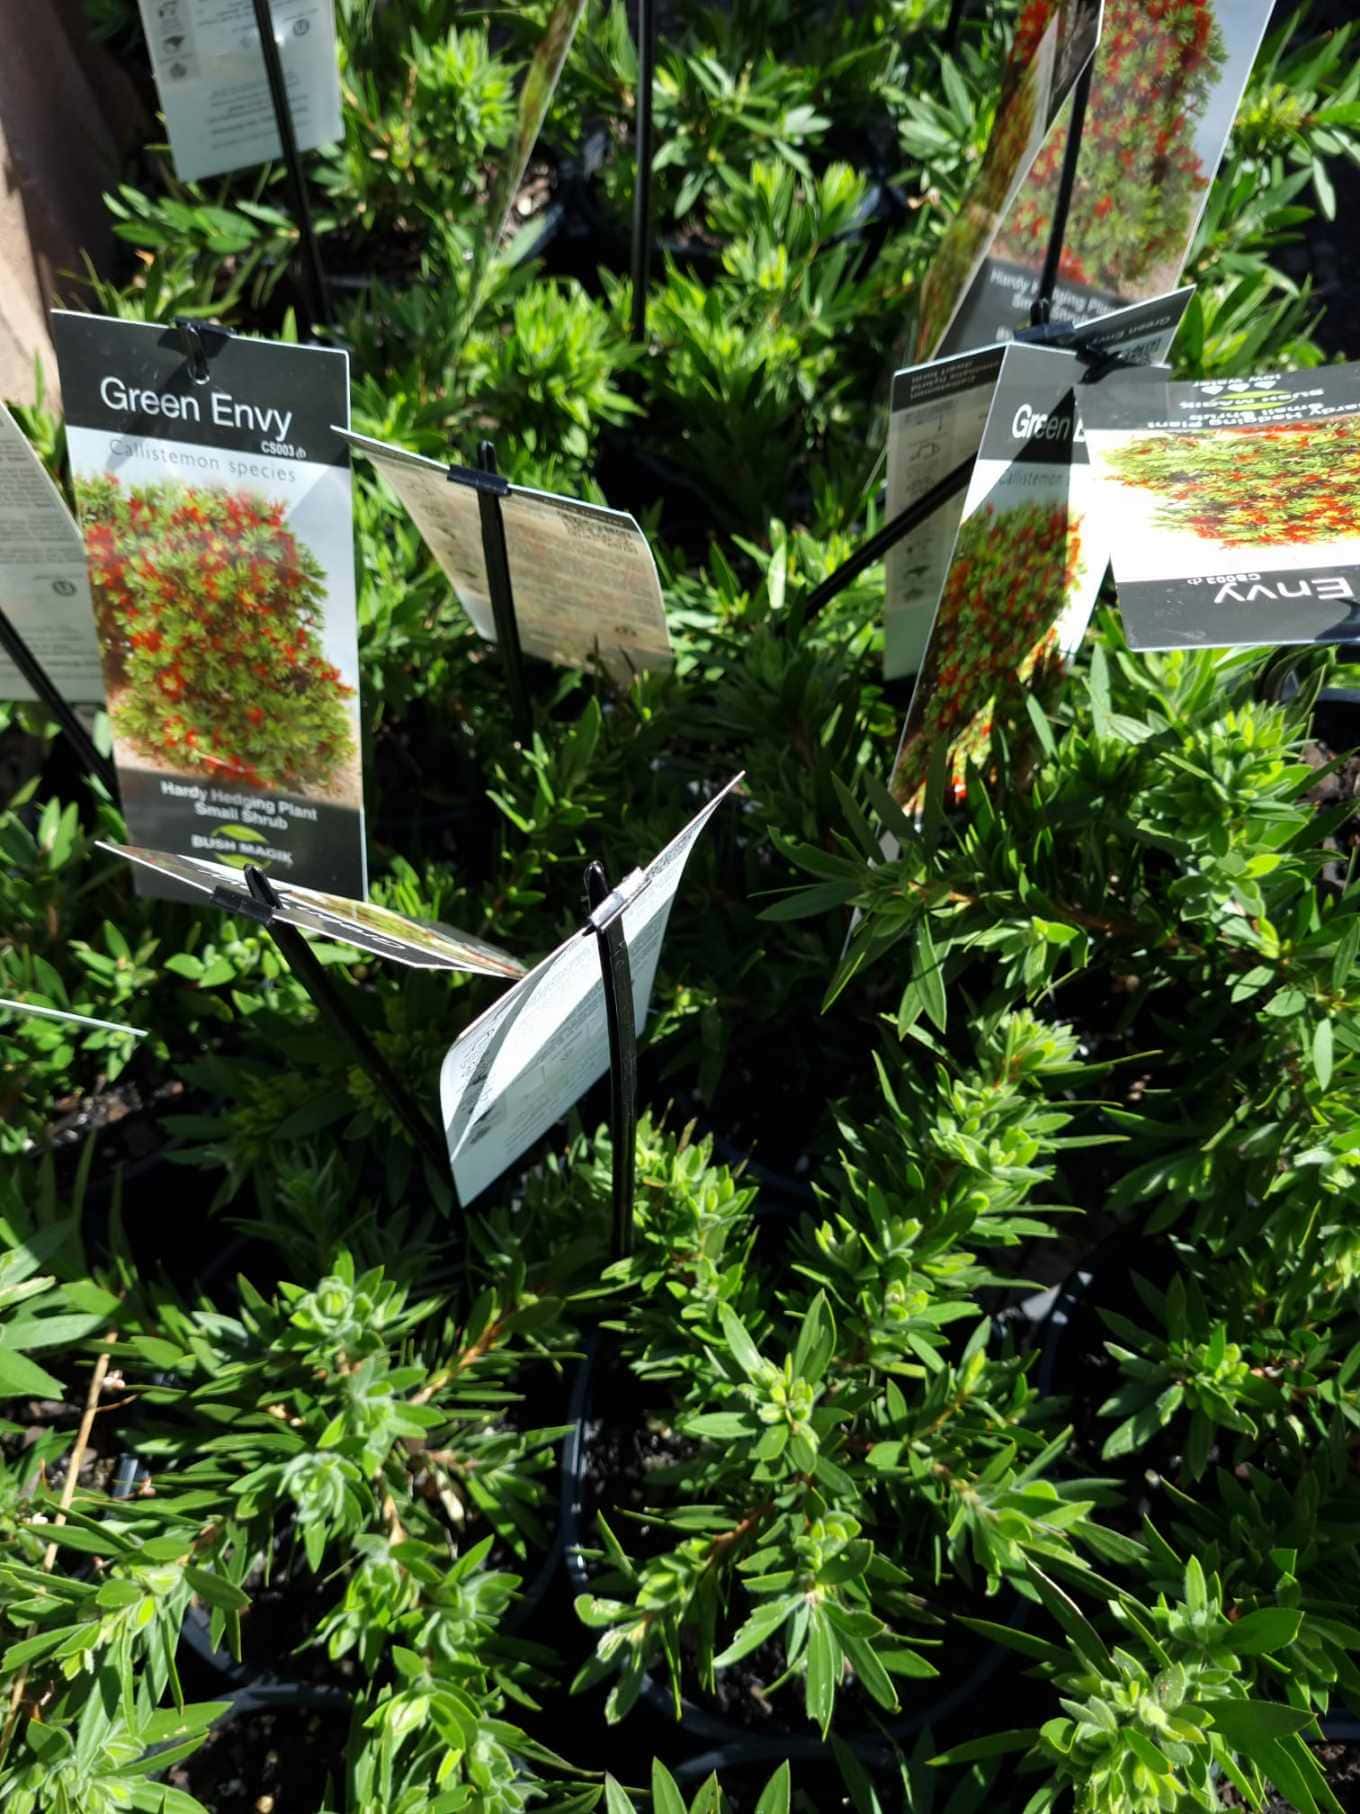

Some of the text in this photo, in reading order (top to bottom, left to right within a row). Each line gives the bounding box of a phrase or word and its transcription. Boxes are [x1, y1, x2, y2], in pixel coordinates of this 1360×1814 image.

[100, 376, 292, 442] Green Envy
[1262, 388, 1325, 402] BUSH
[1012, 403, 1071, 440] Green
[1147, 402, 1360, 429] ardy Hedging Plant
[1189, 402, 1324, 421] Small Shrub
[110, 439, 296, 482] Callistemon species
[1213, 576, 1355, 604] Envy
[160, 780, 318, 822] Hardy Hedging Plant
[194, 801, 288, 831] Small Shrub
[191, 834, 294, 866] BUSH MAGIK
